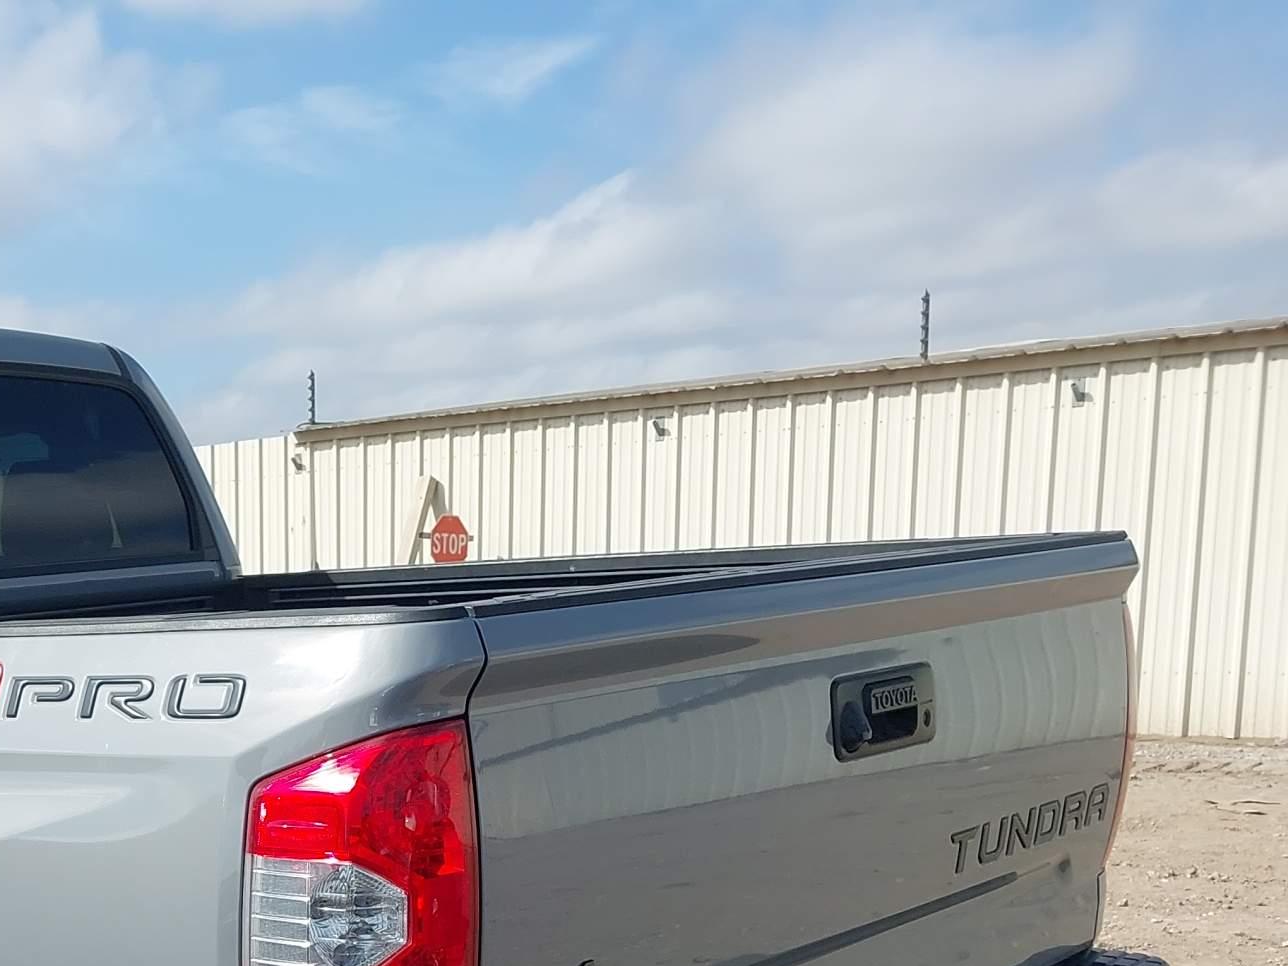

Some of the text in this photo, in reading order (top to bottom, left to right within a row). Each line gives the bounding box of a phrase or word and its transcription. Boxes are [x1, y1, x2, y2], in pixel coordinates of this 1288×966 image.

[433, 532, 467, 555] STOP
[3, 673, 247, 720] PRO
[873, 685, 919, 710] TOYOTA
[950, 783, 1110, 874] TUNDRA
